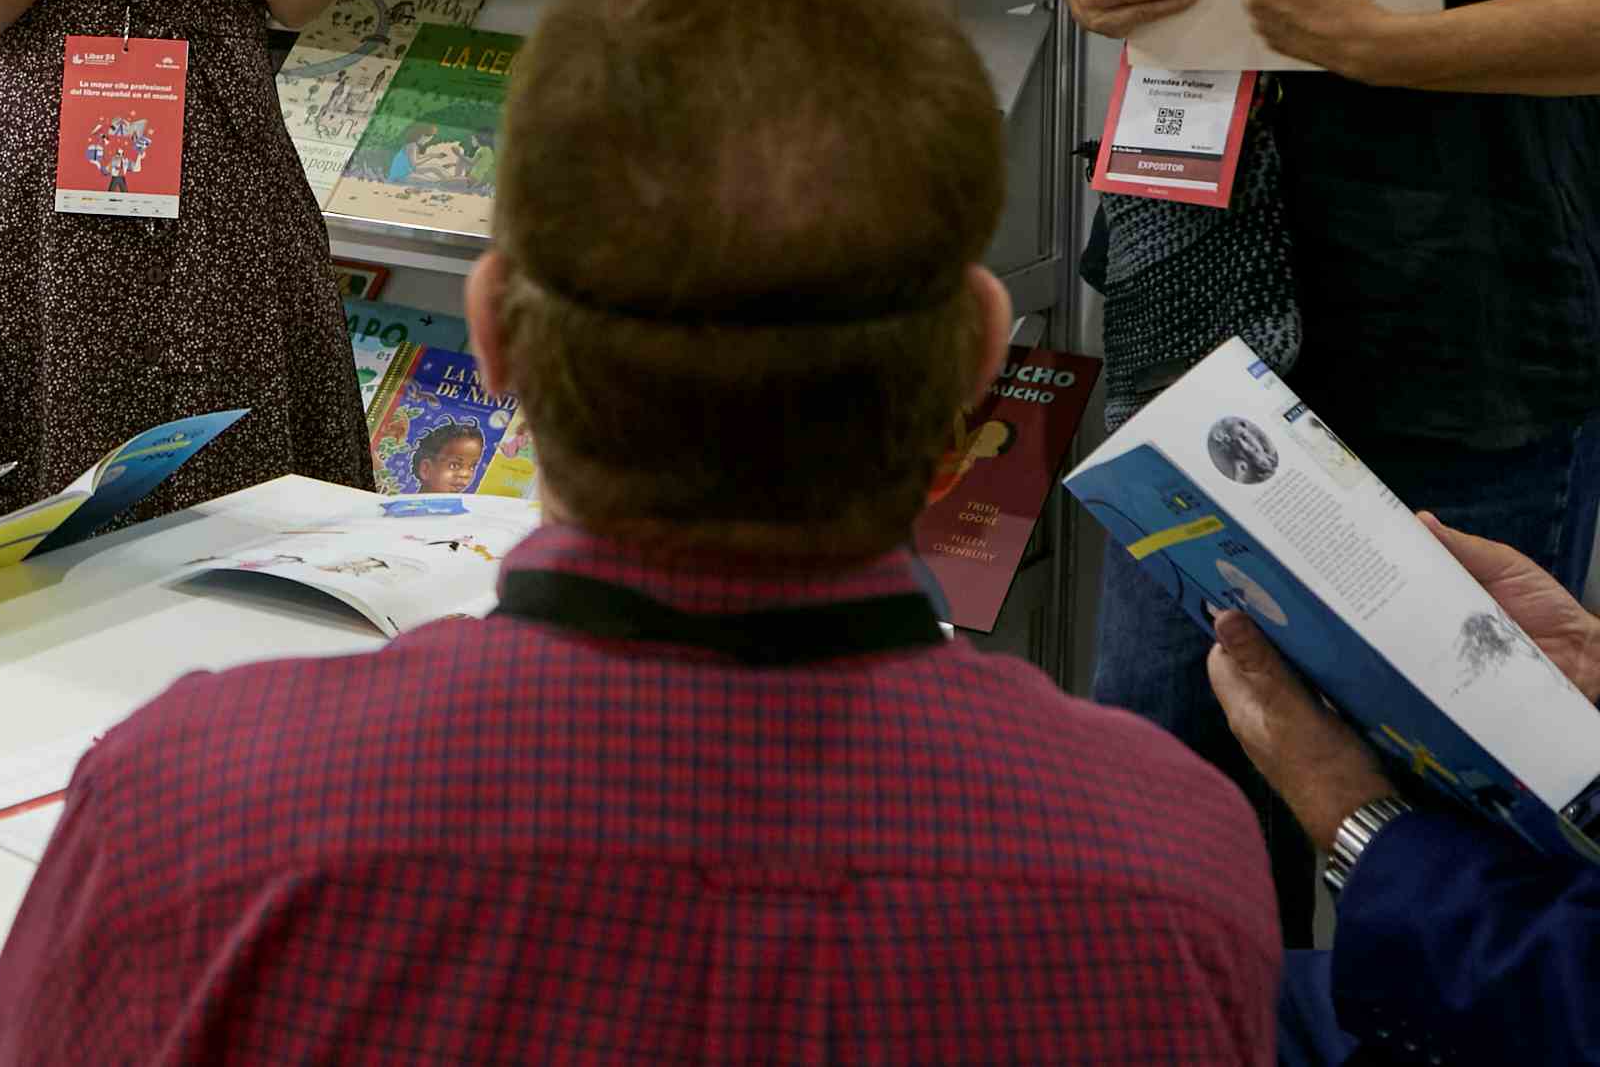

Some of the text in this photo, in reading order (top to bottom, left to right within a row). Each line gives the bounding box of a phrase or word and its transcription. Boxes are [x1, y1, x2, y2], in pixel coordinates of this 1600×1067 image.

[439, 45, 515, 76] LA CE
[79, 80, 89, 88] La
[90, 81, 113, 89] mayor
[130, 83, 173, 92] profesional
[83, 88, 100, 96] libro
[1137, 160, 1185, 173] EXPOSITOR
[442, 364, 466, 383] LA
[997, 363, 1076, 388] UCHO
[435, 382, 520, 411] DE NAND
[990, 383, 1056, 405] UCHO
